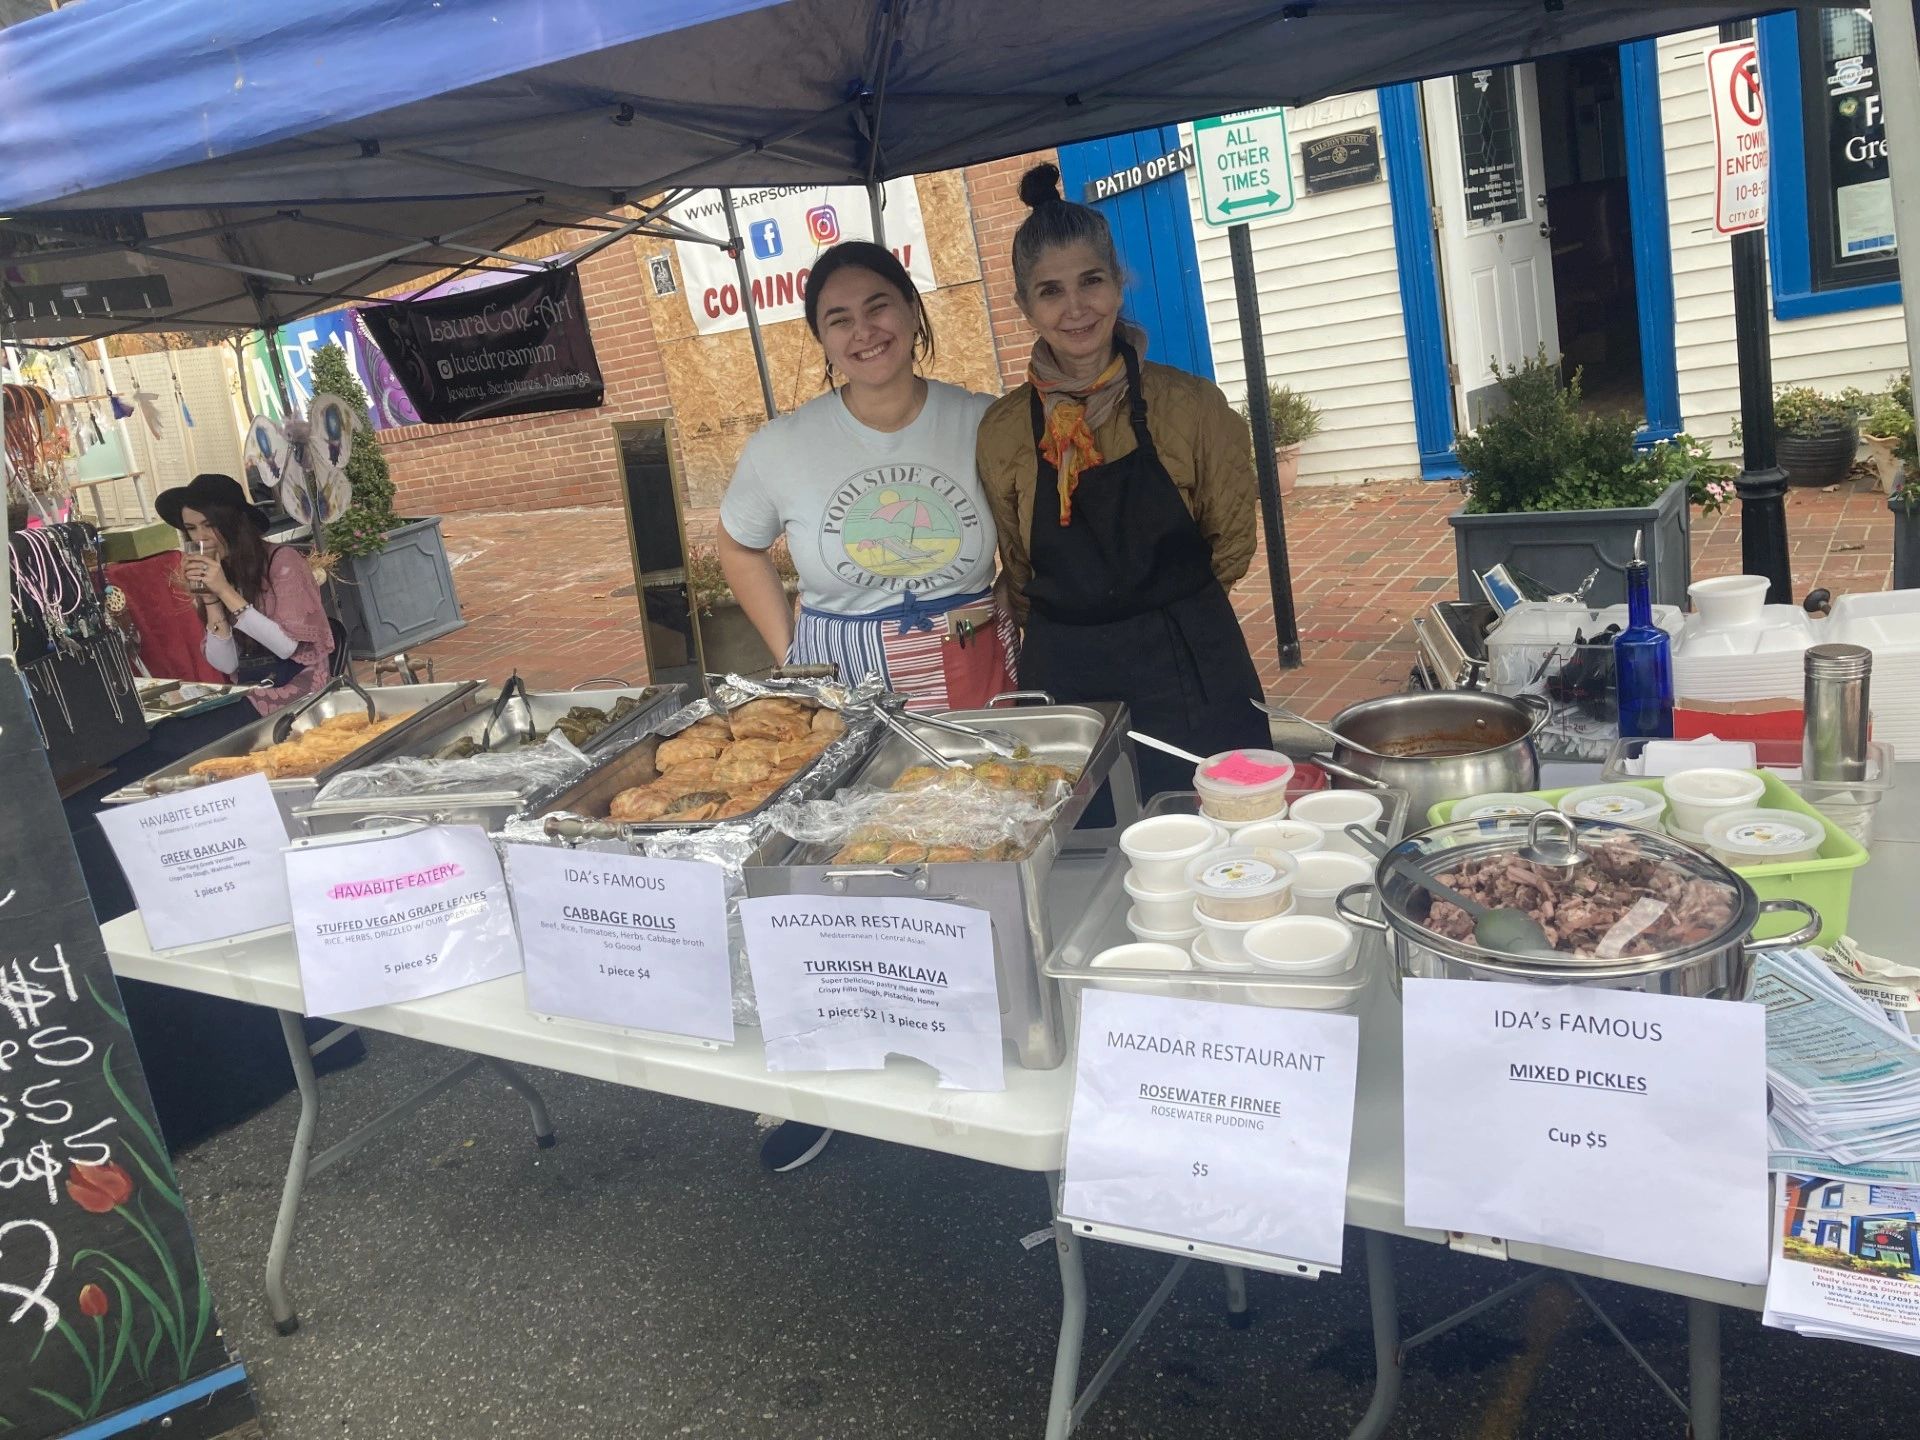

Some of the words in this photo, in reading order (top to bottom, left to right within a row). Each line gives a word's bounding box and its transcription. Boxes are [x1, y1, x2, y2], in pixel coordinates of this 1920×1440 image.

[1226, 127, 1257, 147] ALL
[1217, 146, 1270, 171] OTHER
[1095, 166, 1142, 199] PATIO
[1146, 147, 1192, 180] OPEN
[1222, 169, 1270, 192] TIMES
[1729, 211, 1748, 223] CITY
[1750, 209, 1760, 219] OF
[823, 467, 923, 535] POOLSIDE
[930, 475, 978, 528] CLUB
[139, 808, 192, 830] HAVABITE
[194, 797, 237, 818] EATERY
[160, 850, 192, 866] GREEK
[194, 837, 247, 858] BAKLAVA
[194, 889, 200, 898] 1
[201, 885, 223, 899] piece
[224, 881, 236, 891] $5
[334, 878, 403, 899] HAVABITE
[408, 864, 456, 888] EATERY
[603, 873, 666, 892] FAMOUS
[316, 918, 363, 936] STUFFED
[365, 911, 406, 929] VEGAN
[408, 902, 445, 920] GRAPE
[447, 890, 487, 909] LEAVES
[563, 905, 628, 926] CABBAGE
[632, 913, 676, 930] ROLLS
[375, 924, 413, 939] DRIZZLED
[414, 920, 425, 931] w/
[425, 916, 443, 928] OUR
[560, 923, 578, 934] Rice,
[579, 926, 619, 940] Tomatoes,
[647, 933, 681, 947] Cabbage
[682, 937, 705, 948] broth
[771, 913, 857, 929] MAZADAR
[861, 915, 966, 940] RESTAURANT
[819, 931, 873, 940] Mediterranean
[880, 934, 906, 944] Central
[907, 937, 926, 945] Asian
[603, 941, 613, 949] So
[384, 963, 392, 974] 5
[394, 958, 423, 975] piece
[425, 953, 439, 966] $5
[599, 964, 605, 974] 1
[607, 965, 635, 979] piece
[637, 967, 651, 980] $4
[803, 960, 873, 973] TURKISH
[877, 961, 948, 986] BAKLAVA
[818, 986, 841, 994] Crispy
[859, 987, 883, 998] Dough,
[883, 991, 915, 1004] Pistachio,
[917, 997, 940, 1007] Honey
[820, 977, 842, 986] Super
[844, 977, 875, 986] Delicious
[876, 980, 897, 991] pastry
[898, 984, 918, 993] made
[919, 987, 936, 996] with
[1880, 992, 1909, 1002] EATERY
[818, 1008, 825, 1017] 1
[828, 1008, 860, 1019] piece
[862, 1008, 876, 1020] $2
[889, 1013, 896, 1024] 3
[898, 1017, 928, 1030] piece
[931, 1020, 947, 1033] $5
[1560, 1013, 1662, 1042] FAMOUS
[1107, 1031, 1196, 1057] MAZADAR
[1201, 1042, 1326, 1073] RESTAURANT
[1509, 1062, 1570, 1085] MIXED
[1575, 1070, 1648, 1093] PICKLES
[1139, 1083, 1226, 1108] ROSEWATER
[1230, 1095, 1282, 1116] FIRNEE
[1151, 1105, 1212, 1124] ROSEWATER
[1215, 1114, 1265, 1131] PUDDING
[1548, 1127, 1582, 1148] Cup
[1586, 1130, 1608, 1149] $5
[1191, 1161, 1209, 1177] $5
[1881, 1287, 1911, 1297] Dinner
